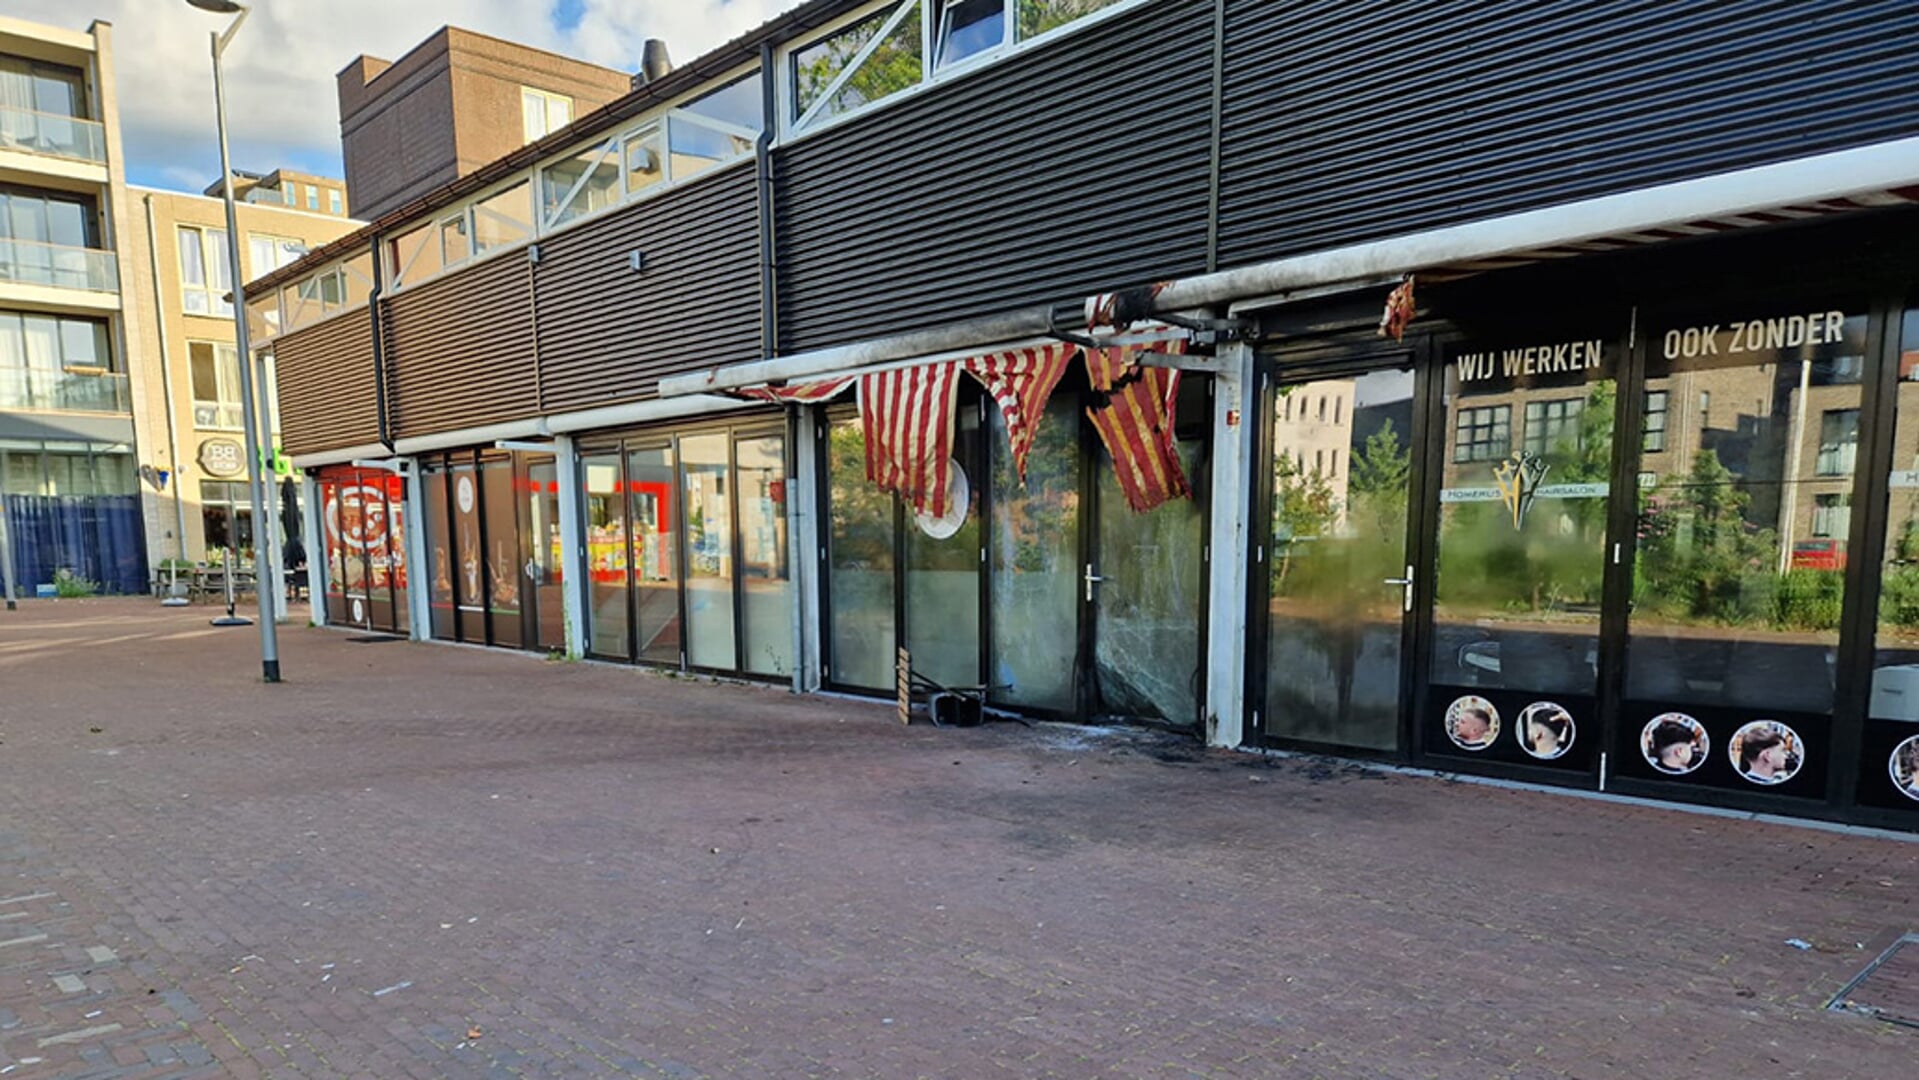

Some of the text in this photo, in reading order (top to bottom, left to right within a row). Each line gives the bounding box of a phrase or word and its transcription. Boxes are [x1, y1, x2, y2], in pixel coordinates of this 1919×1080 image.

[1664, 310, 1845, 360] OOK ZONDER
[1457, 339, 1602, 382] WIJ WERKEN
[1536, 486, 1597, 496] HAIRSALON
